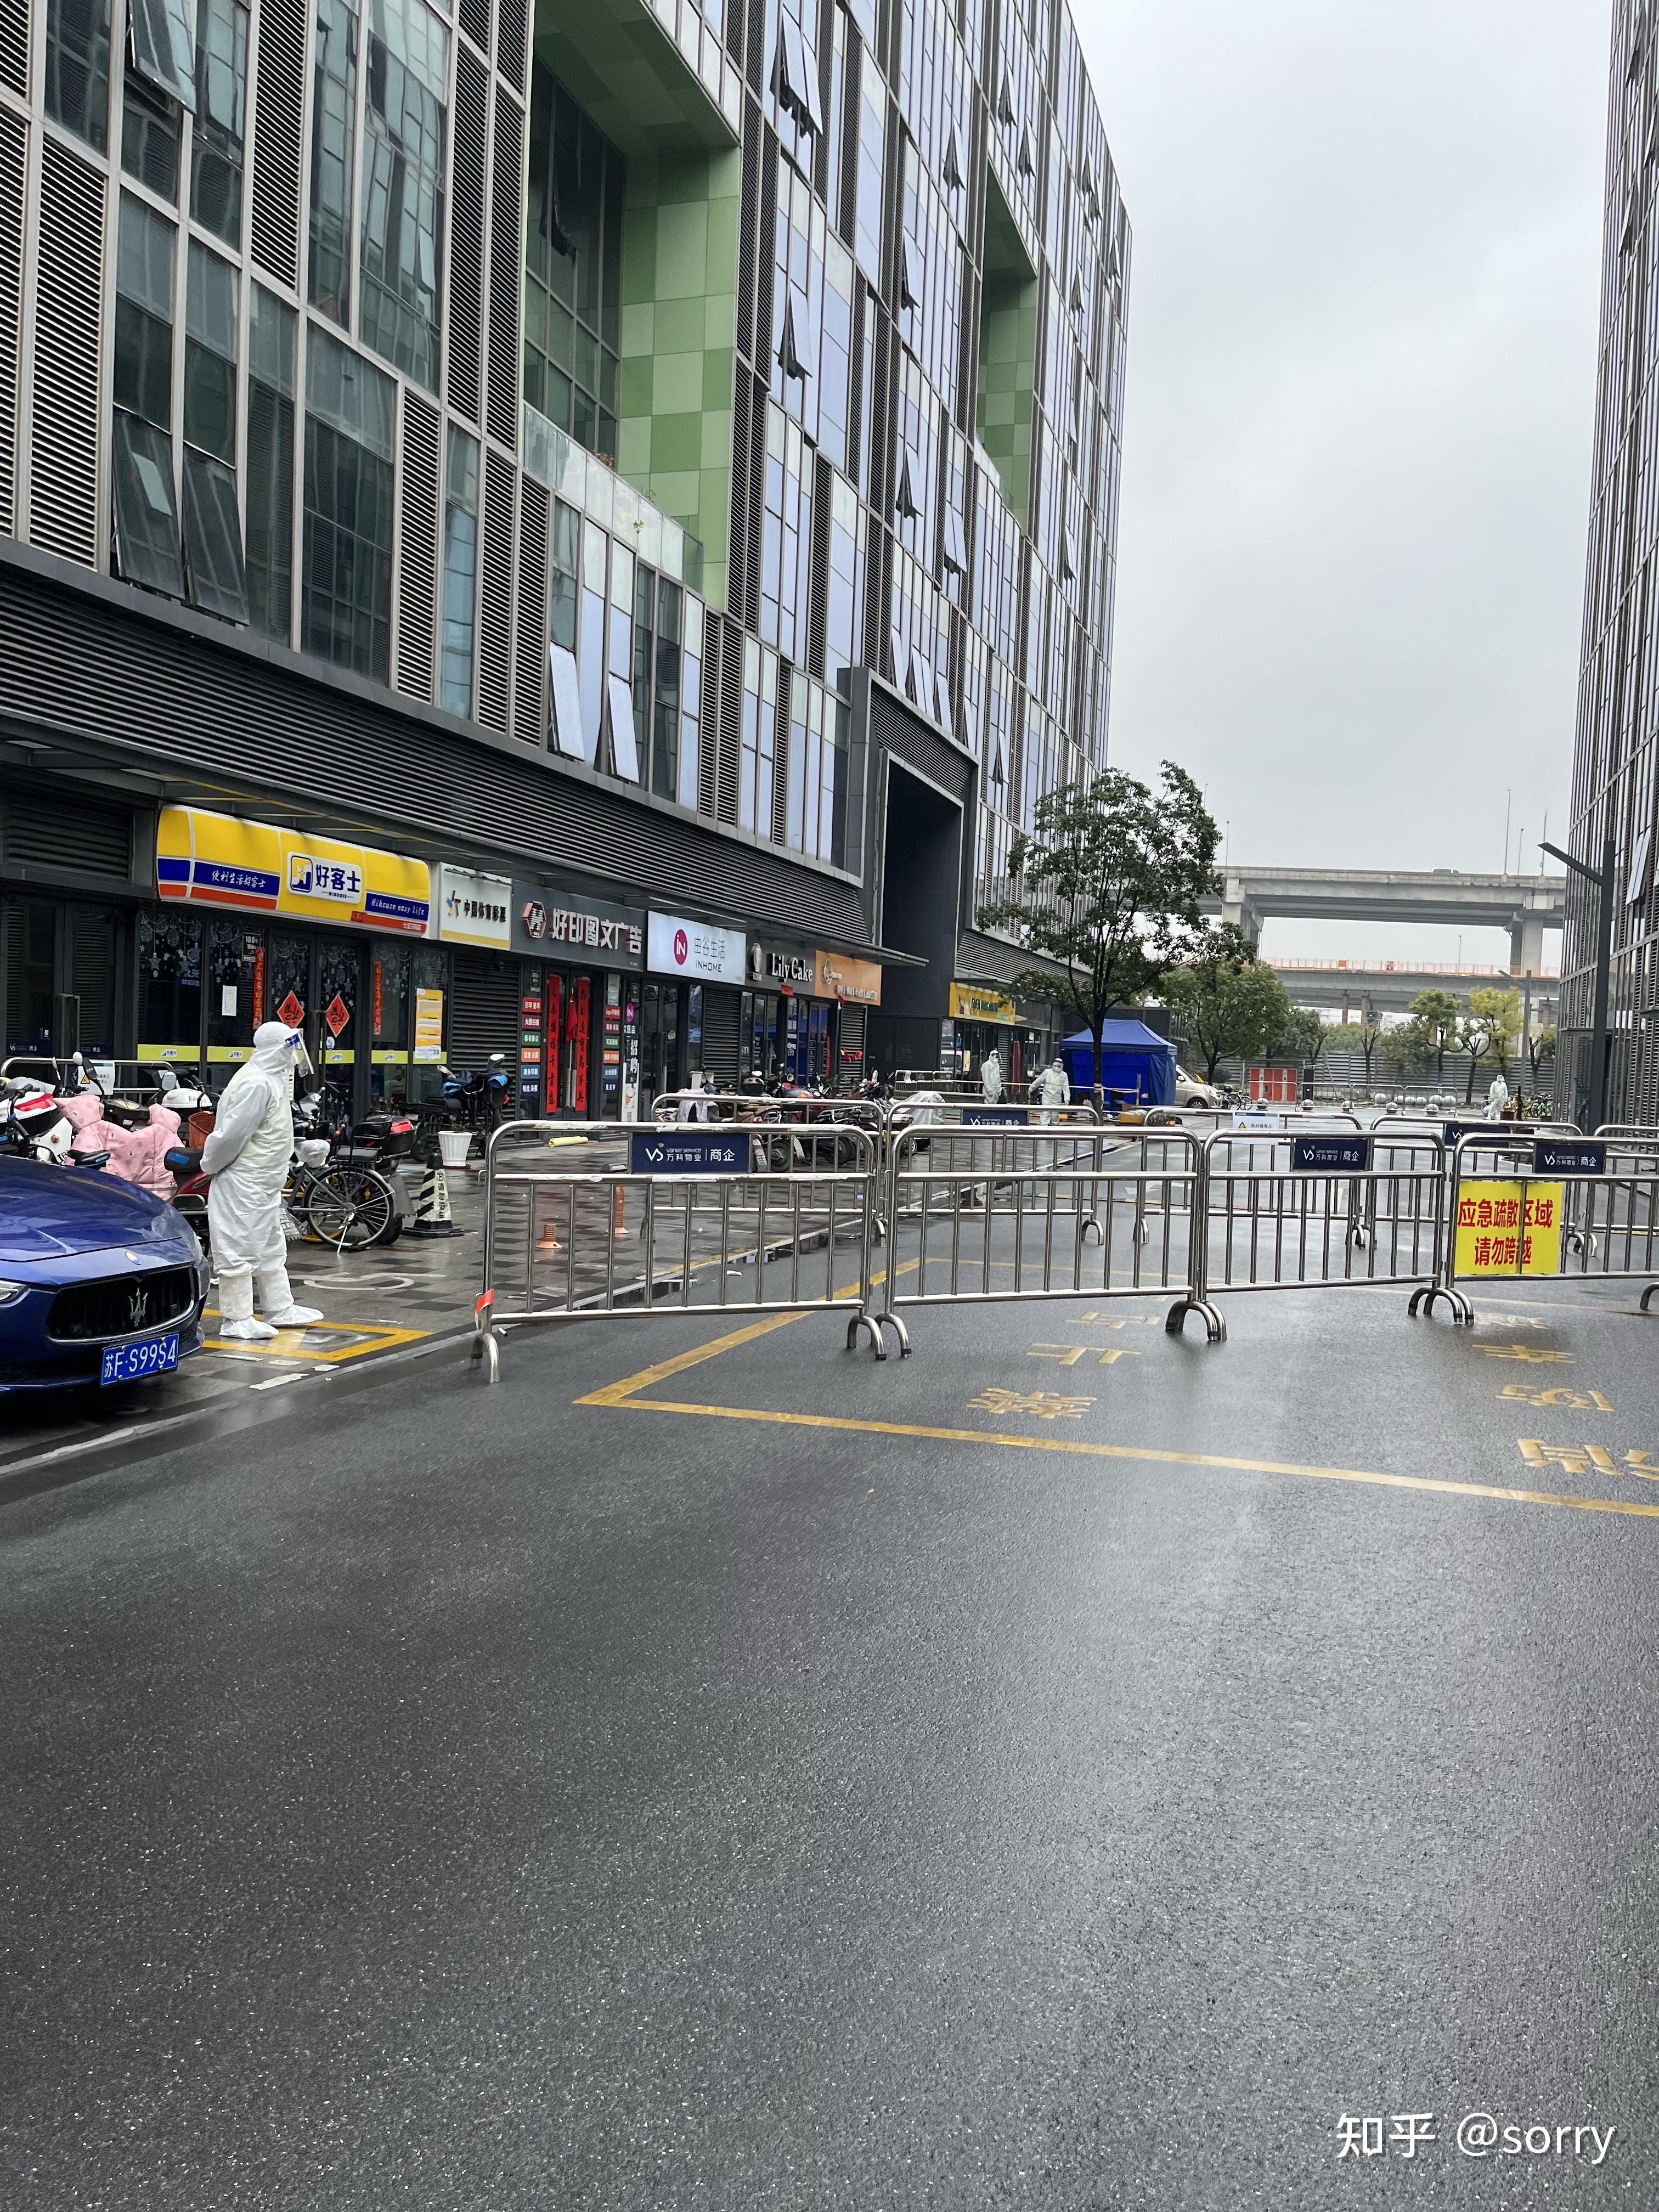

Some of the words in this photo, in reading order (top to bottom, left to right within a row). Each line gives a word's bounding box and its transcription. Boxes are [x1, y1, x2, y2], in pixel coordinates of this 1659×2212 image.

[212, 870, 266, 888] 便利生活好客士
[315, 864, 361, 893] 好客士
[371, 898, 396, 911] Hihouse
[398, 905, 411, 913] easy
[412, 905, 425, 916] life
[552, 908, 642, 955] 好印图文广告
[694, 934, 725, 959] 由谷生活
[771, 953, 790, 983] Lily
[791, 957, 813, 982] Cake
[710, 1148, 735, 1161] 商企
[1343, 1150, 1359, 1161] 商企
[1581, 1156, 1596, 1166] 商企
[1457, 1198, 1554, 1228] 应急疏散区域
[1474, 1235, 1532, 1266] 请勿跨越
